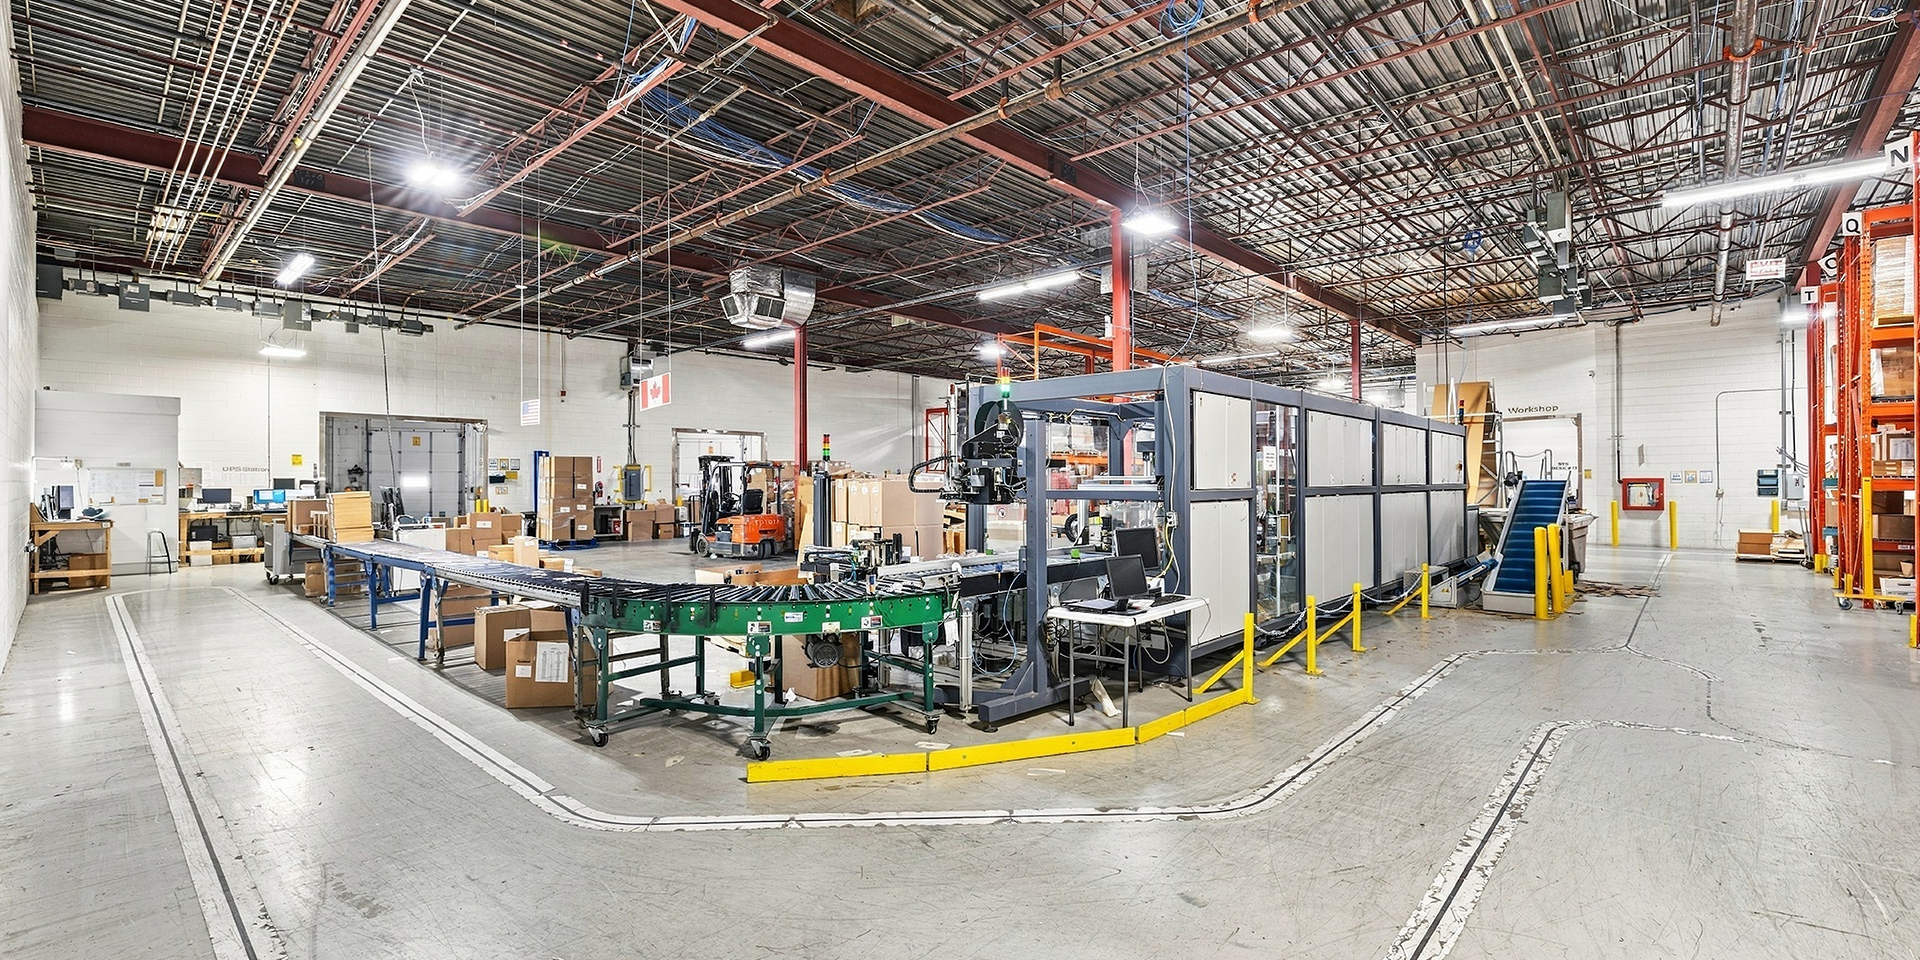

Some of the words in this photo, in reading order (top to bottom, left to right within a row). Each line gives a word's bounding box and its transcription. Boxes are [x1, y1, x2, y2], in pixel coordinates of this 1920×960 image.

[1890, 145, 1909, 167] N
[1846, 218, 1861, 234] Q
[1804, 290, 1815, 301] T
[1507, 405, 1559, 414] Workshop
